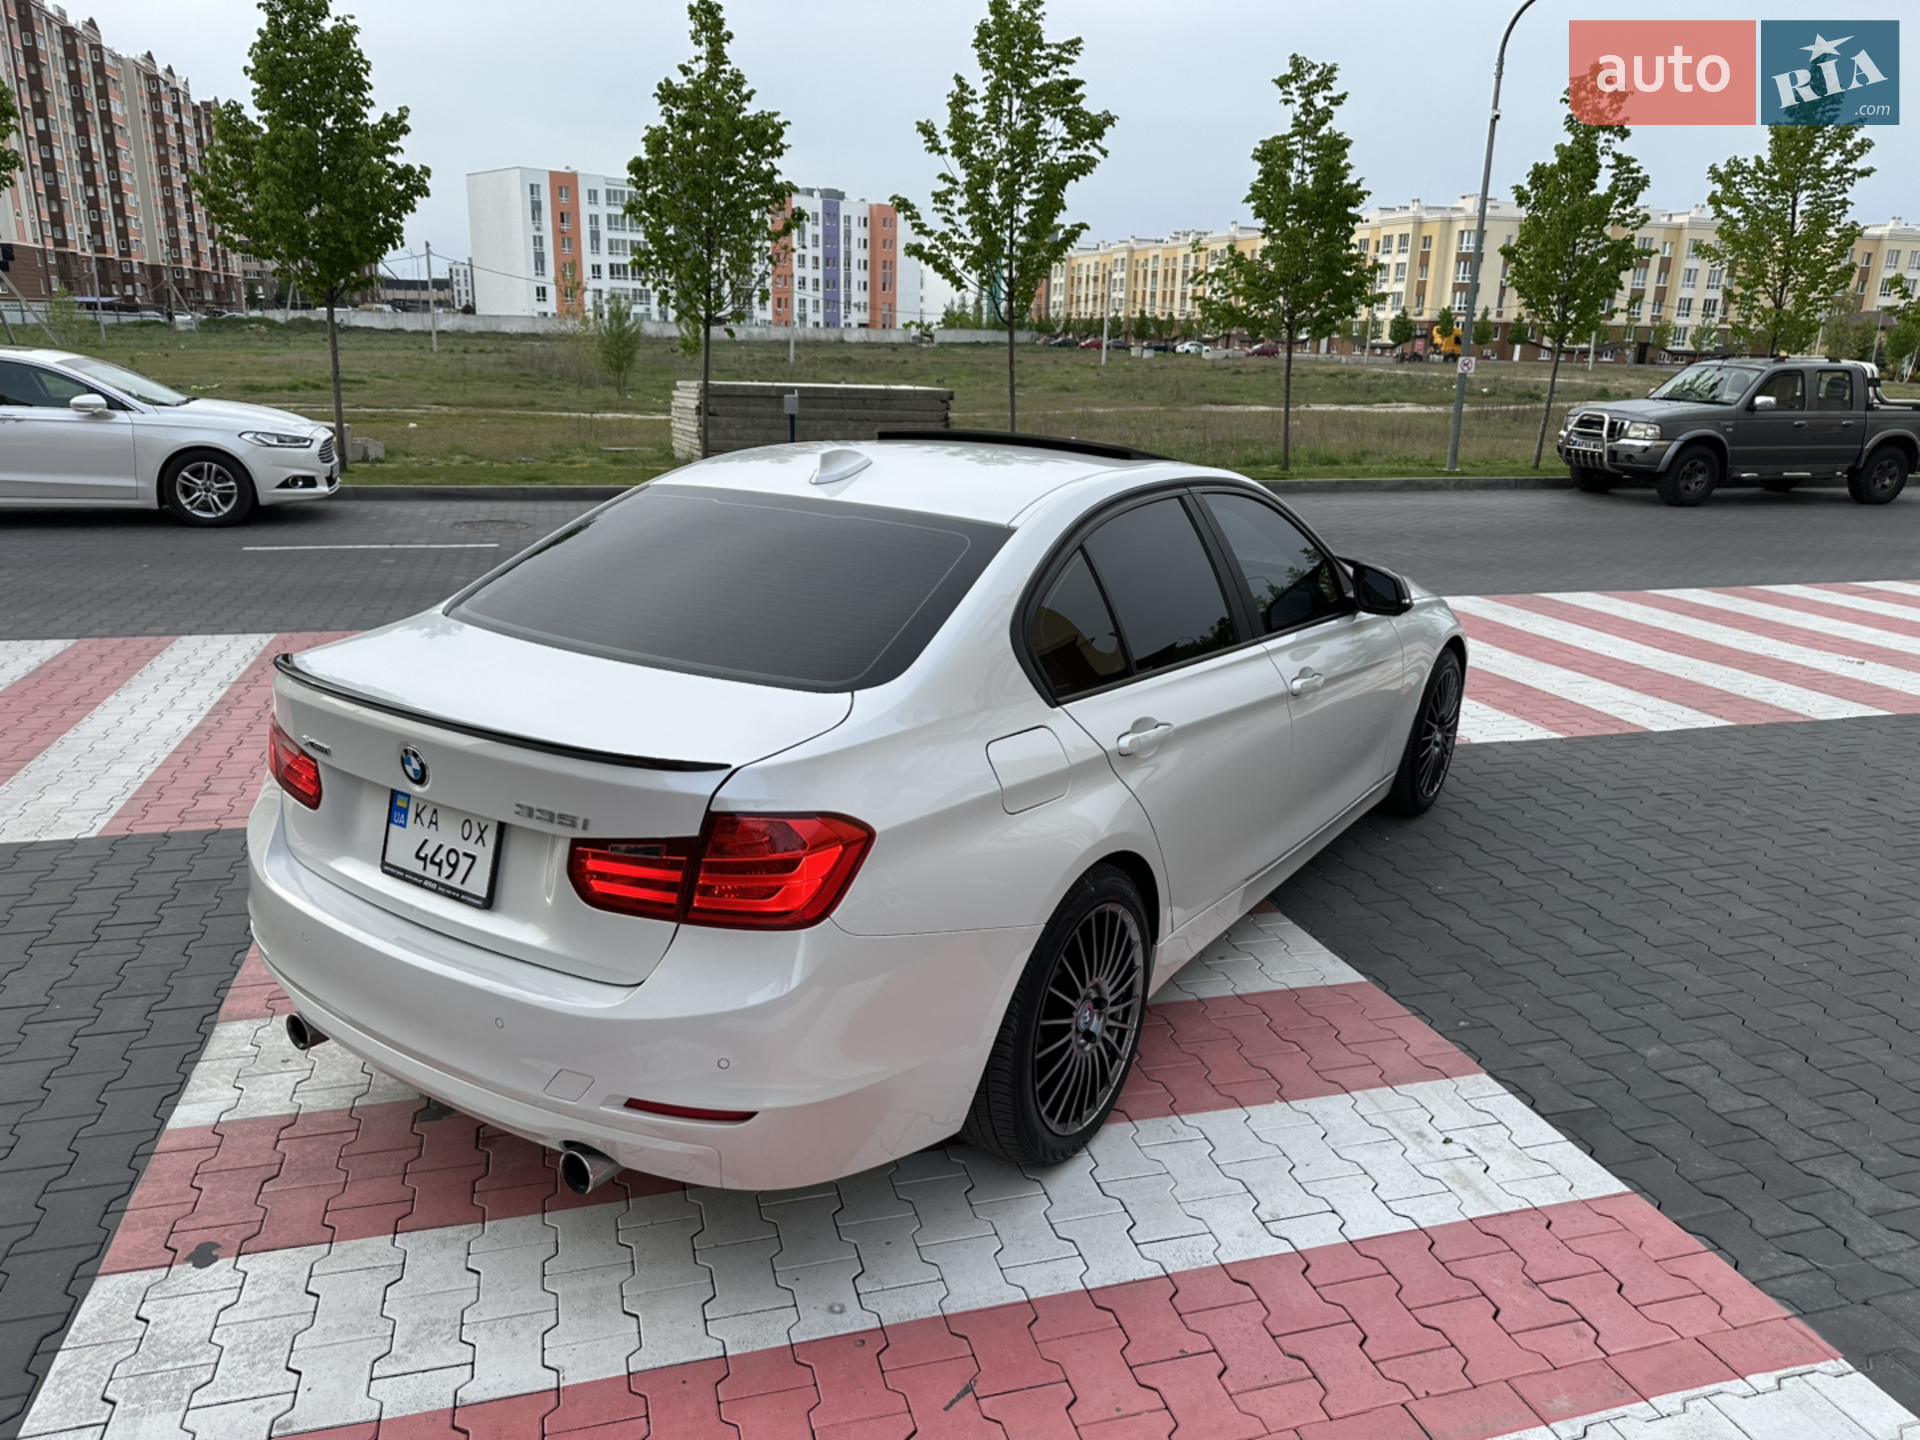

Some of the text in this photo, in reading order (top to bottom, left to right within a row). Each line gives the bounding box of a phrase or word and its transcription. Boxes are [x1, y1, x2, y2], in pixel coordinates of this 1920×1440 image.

[393, 811, 405, 826] UA
[413, 802, 439, 832] KA
[415, 838, 477, 885] 4497
